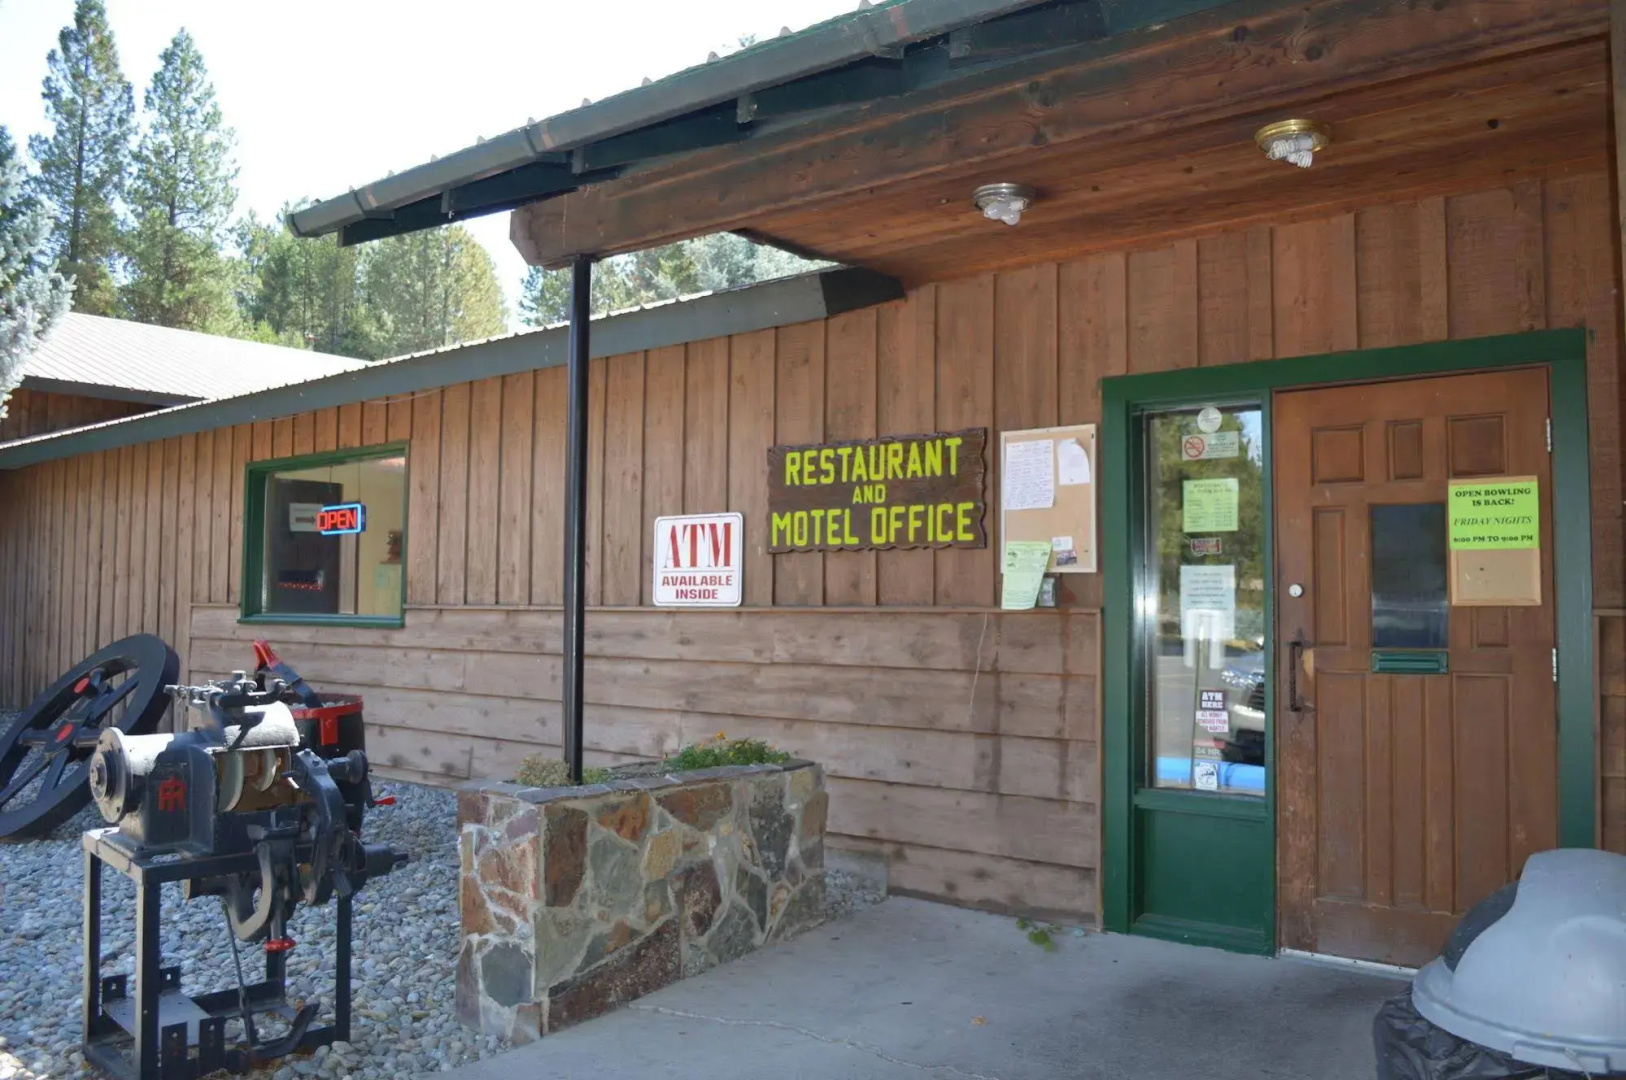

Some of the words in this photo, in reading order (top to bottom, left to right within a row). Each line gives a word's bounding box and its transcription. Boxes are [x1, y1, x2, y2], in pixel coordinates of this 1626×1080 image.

[786, 437, 963, 486] RESTAURANT
[852, 484, 886, 504] AND
[1484, 488, 1531, 496] BOWLING
[1484, 498, 1515, 506] BACK!
[316, 510, 357, 530] OPEN
[771, 508, 859, 547] MOTEL
[871, 502, 974, 545] OFFICE
[1453, 517, 1490, 526] FRIDAY
[1494, 515, 1532, 525] NIGHTS
[662, 522, 732, 568] ATM
[661, 575, 733, 587] AVAILABLE
[675, 588, 719, 600] INSIDE
[1201, 691, 1223, 701] ATM
[1201, 701, 1223, 709] HERE
